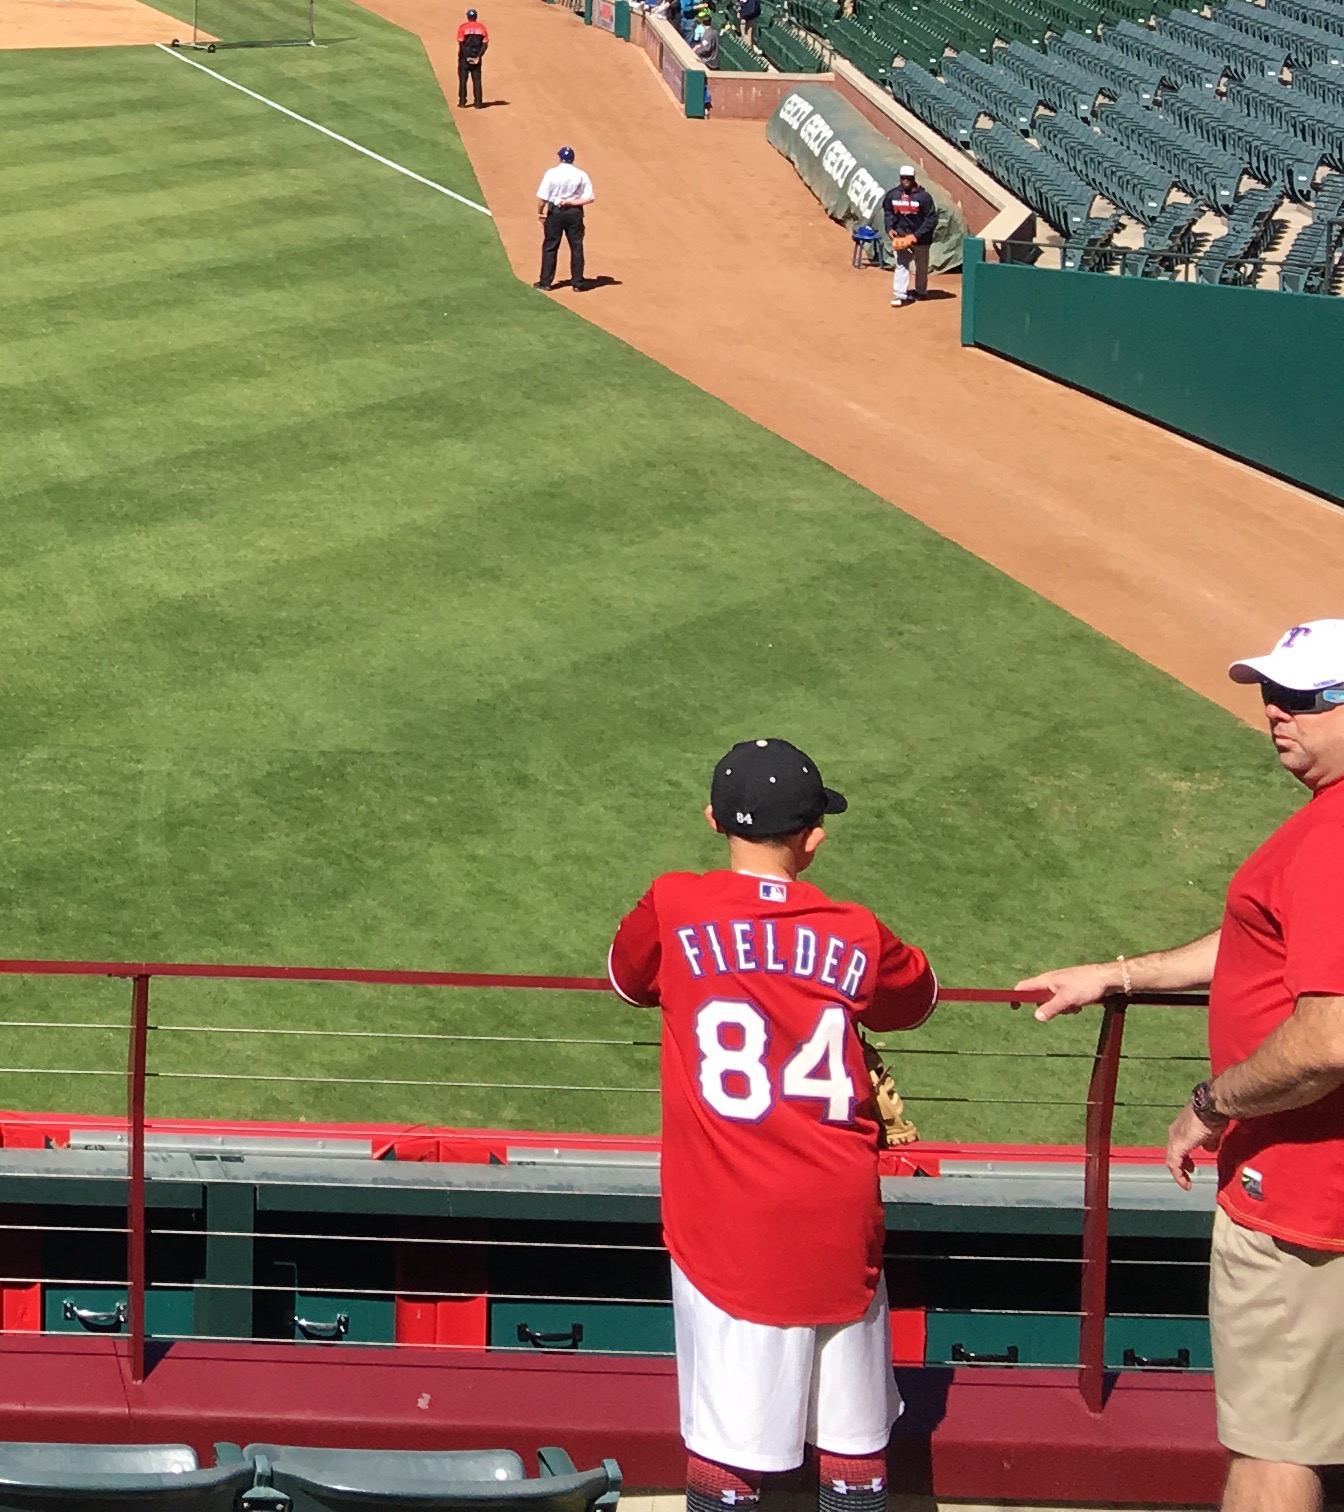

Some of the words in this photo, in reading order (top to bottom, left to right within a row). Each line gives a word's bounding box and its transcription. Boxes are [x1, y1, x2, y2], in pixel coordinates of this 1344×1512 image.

[779, 93, 814, 130] GEICO
[800, 113, 834, 158] GEICO
[822, 140, 858, 188] GEICO
[847, 168, 886, 220] GEICO
[1281, 626, 1312, 648] T
[736, 812, 753, 826] 84
[674, 919, 867, 1000] FIELDER
[693, 995, 856, 1126] 84
